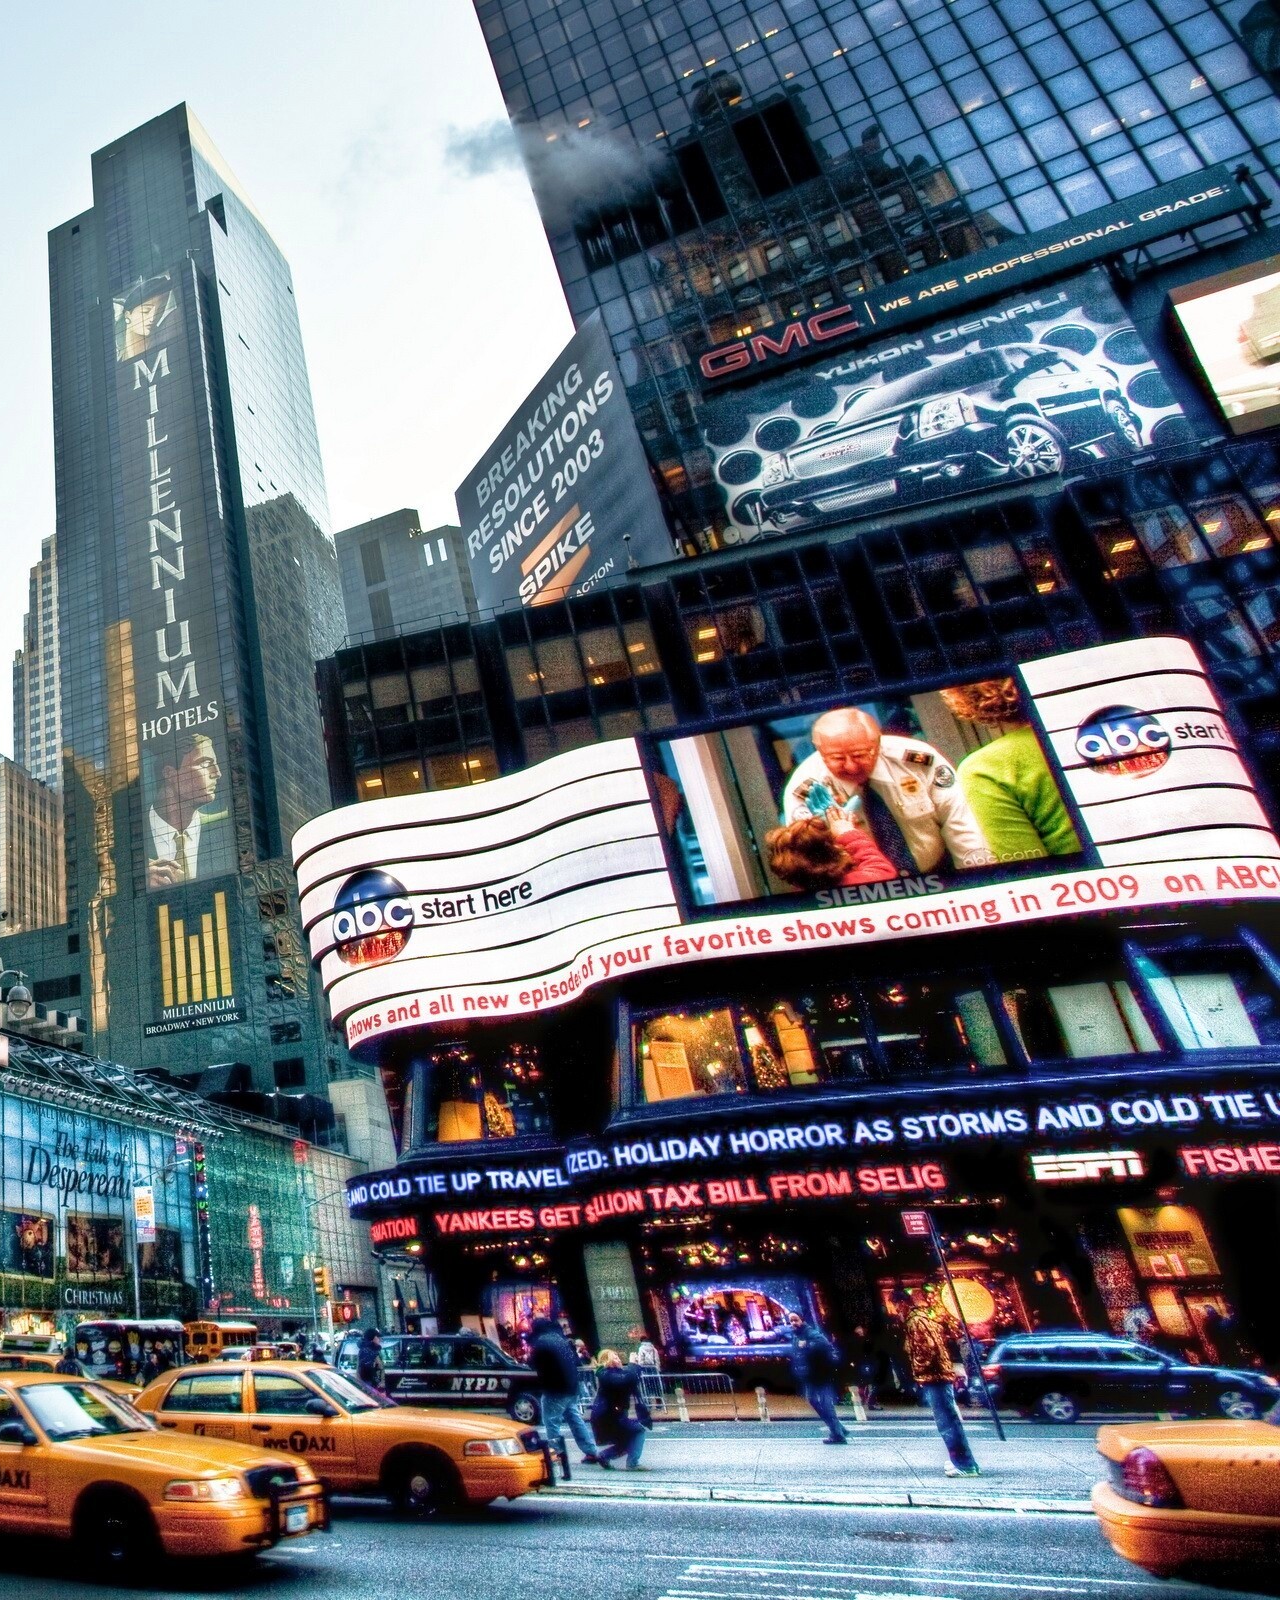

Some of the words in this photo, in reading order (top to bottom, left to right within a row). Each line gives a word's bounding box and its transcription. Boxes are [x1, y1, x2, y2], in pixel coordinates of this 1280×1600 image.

[699, 304, 860, 378] GMC
[879, 296, 912, 313] WE
[918, 280, 959, 301] ARE
[964, 220, 1134, 284] PROFESSIONAL
[815, 338, 925, 381] YUKON
[933, 291, 1069, 344] DENALI
[476, 363, 584, 508] BREAKING
[467, 370, 614, 560] RESOLUTIONS
[488, 489, 551, 574] SINCE
[551, 428, 605, 503] 2003
[133, 347, 200, 710] MILLENNIUM
[519, 511, 596, 605] SPIKE
[575, 557, 614, 599] ACTION
[142, 700, 219, 741] HOTELS
[1075, 716, 1171, 760] abc
[1174, 722, 1225, 740] start
[962, 848, 1043, 867] abc.com
[333, 893, 413, 941] abc
[421, 894, 476, 919] start
[482, 881, 533, 912] here
[815, 874, 944, 910] SIEMENS
[387, 999, 421, 1024] and
[429, 994, 455, 1016] all
[463, 993, 509, 1012] new
[581, 955, 595, 979] of
[600, 940, 652, 979] your
[663, 925, 773, 957] favorite
[783, 916, 876, 943] shows
[886, 894, 1001, 933] coming
[1008, 889, 1042, 914] in
[1051, 873, 1140, 909] 2009
[1164, 873, 1207, 894] on
[145, 1020, 191, 1035] BROADWAY
[195, 1016, 215, 1027] NEW
[216, 1012, 240, 1023] YORK
[163, 998, 236, 1019] MILLENNIUM
[614, 1135, 721, 1166] HOLIDAY
[729, 1123, 844, 1154] HORROR
[853, 1120, 894, 1144] AS
[903, 1109, 1027, 1141] STORMS
[1037, 1102, 1105, 1132] AND
[1110, 1097, 1200, 1127] COLD
[1203, 1093, 1262, 1119] TIE
[370, 1179, 412, 1201] COLD
[415, 1174, 447, 1195] TIE
[452, 1172, 481, 1192] UP
[486, 1168, 569, 1190] TRAVEL
[647, 1183, 704, 1209] TAX
[707, 1179, 767, 1204] BILL
[769, 1170, 853, 1199] FROM
[858, 1163, 946, 1193] SELIG
[1031, 1150, 1144, 1180] ESPN
[435, 1209, 535, 1233] YANKEES
[539, 1206, 582, 1228] GET
[64, 1287, 124, 1306] CHRISTMAS
[450, 1377, 498, 1391] NYPD
[289, 1430, 336, 1453] TAXI
